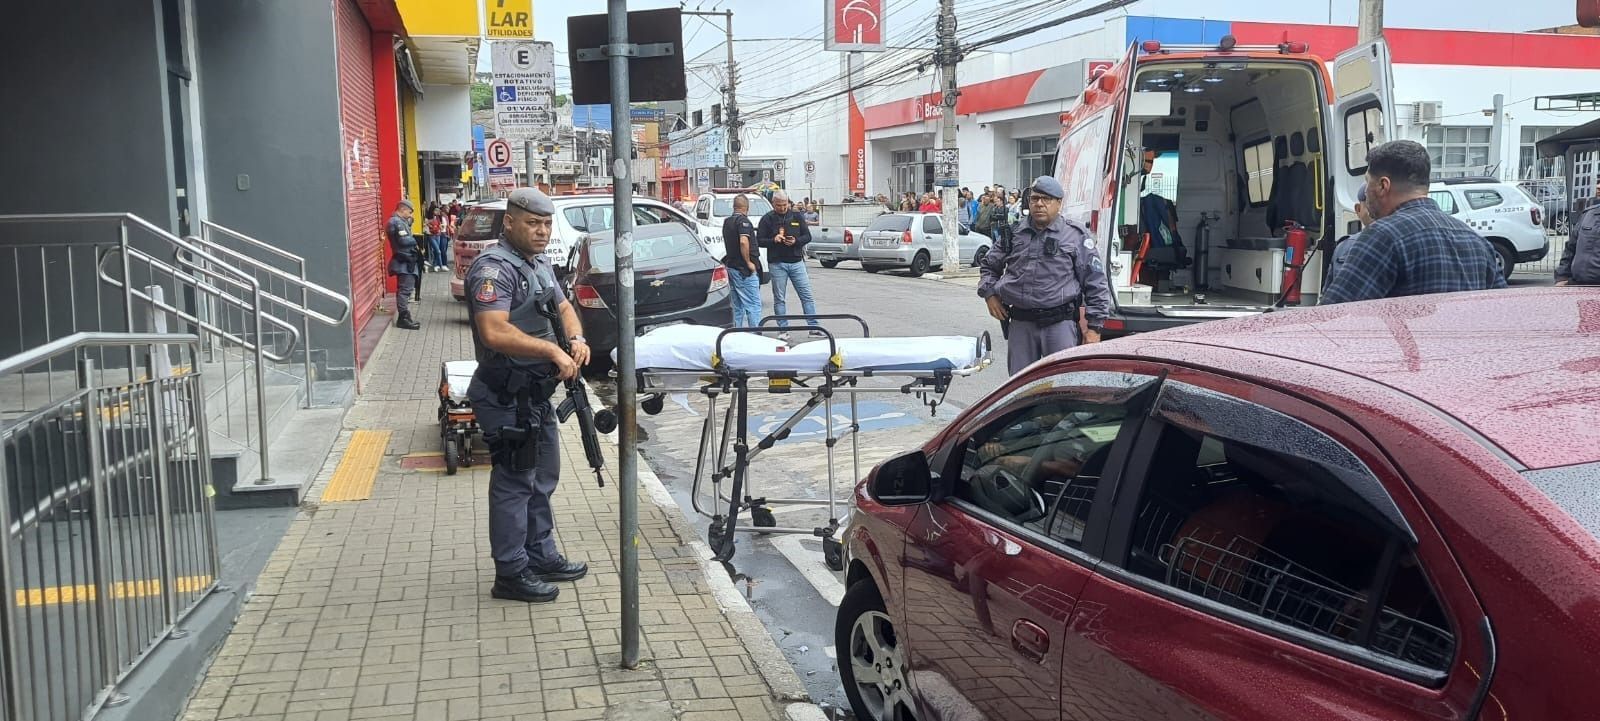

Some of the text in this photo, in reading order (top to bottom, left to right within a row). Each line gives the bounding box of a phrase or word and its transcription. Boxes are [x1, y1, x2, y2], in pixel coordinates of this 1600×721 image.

[490, 11, 528, 27] LAR
[487, 29, 533, 37] UTILIDADES
[517, 50, 529, 65] E
[495, 145, 505, 163] E
[934, 149, 959, 157] ROCK
[857, 148, 865, 189] Bradesco
